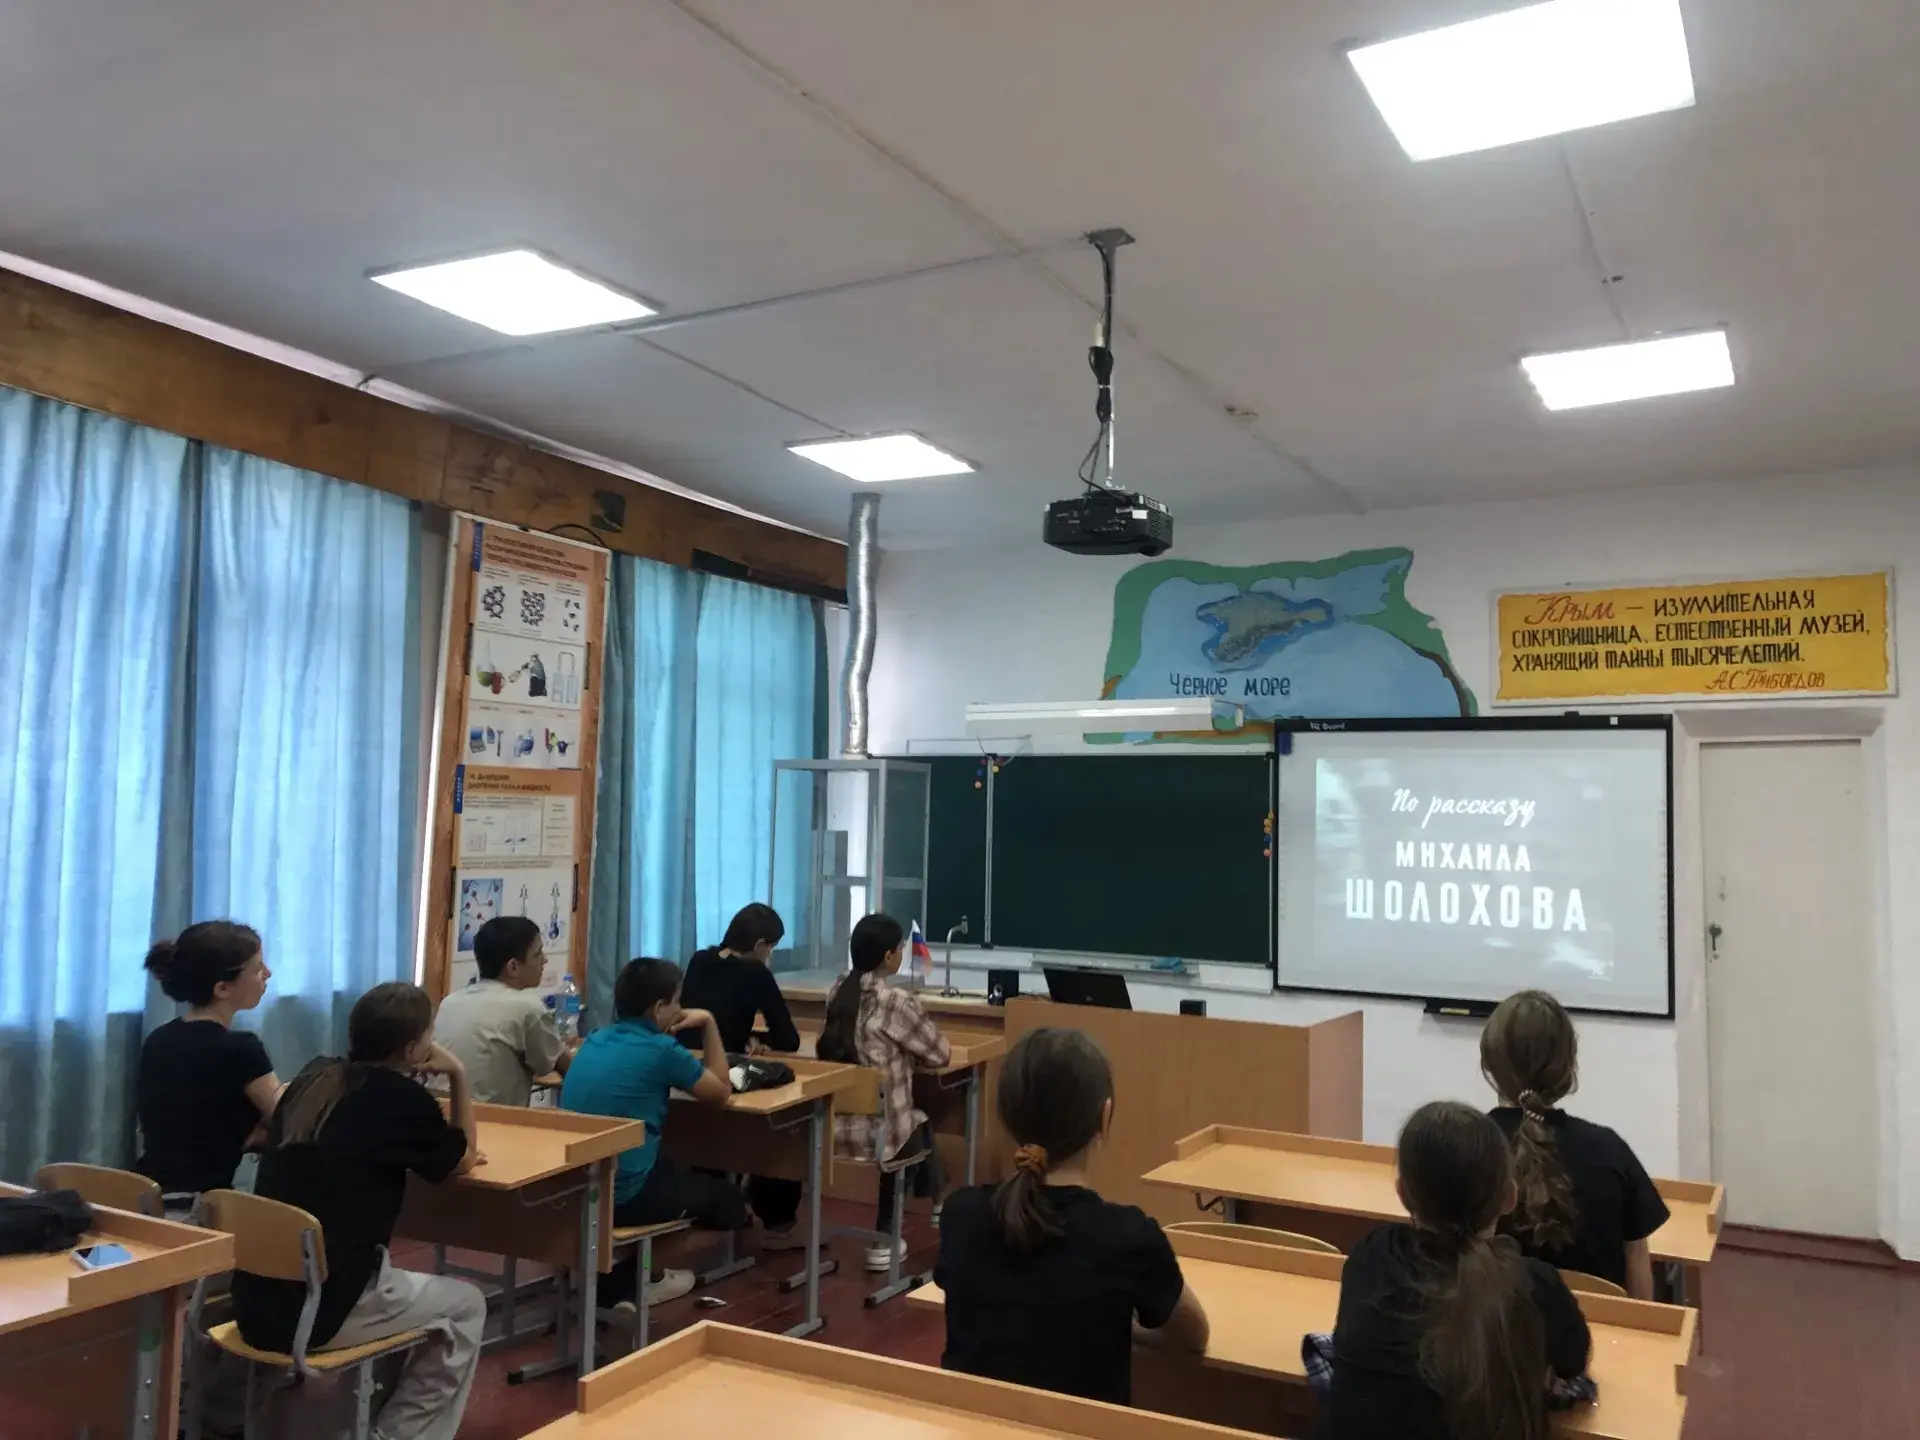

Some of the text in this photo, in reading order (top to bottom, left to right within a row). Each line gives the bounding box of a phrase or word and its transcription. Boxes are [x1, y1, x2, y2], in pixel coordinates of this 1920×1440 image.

[1654, 589, 1816, 617] ИЗУМИТЕЛЬНАЯ
[1655, 614, 1791, 642] ЕСТЕСТВЕННЫЙ
[1511, 648, 1599, 672] ХРАНЯЩИЙ
[1605, 646, 1664, 669] ТАЙНЫ
[1391, 787, 1536, 829] По рассказу
[1396, 840, 1531, 872] МИХАИЛА
[1345, 878, 1587, 932] ШОЛОХОВА
